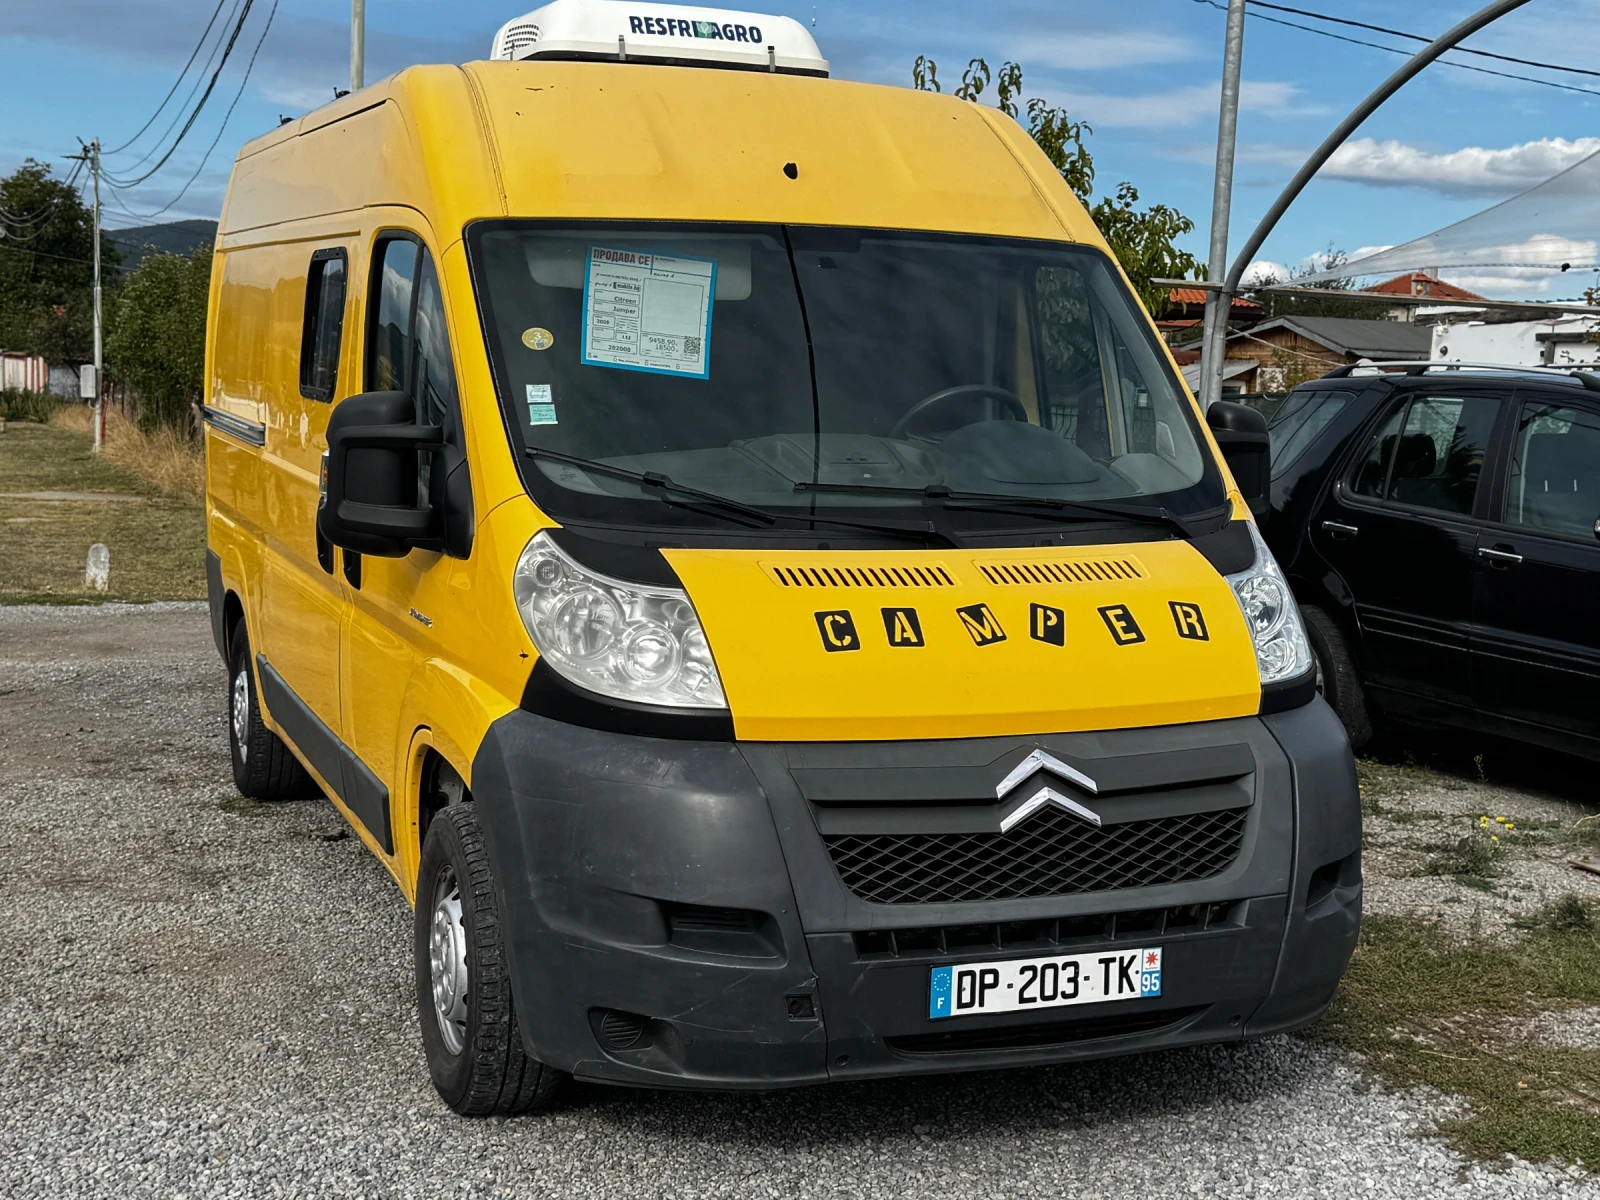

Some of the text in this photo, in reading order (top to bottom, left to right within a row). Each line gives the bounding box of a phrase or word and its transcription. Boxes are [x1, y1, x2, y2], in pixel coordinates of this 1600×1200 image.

[592, 248, 636, 264] ПРОДАВА
[638, 255, 650, 266] СЕ
[613, 296, 637, 304] Citroen
[612, 306, 636, 315] Jumper
[648, 336, 676, 346] 9458.90
[655, 343, 676, 352] 18500
[822, 603, 1205, 648] CAMPER
[1141, 973, 1160, 992] 95
[937, 997, 945, 1009] F
